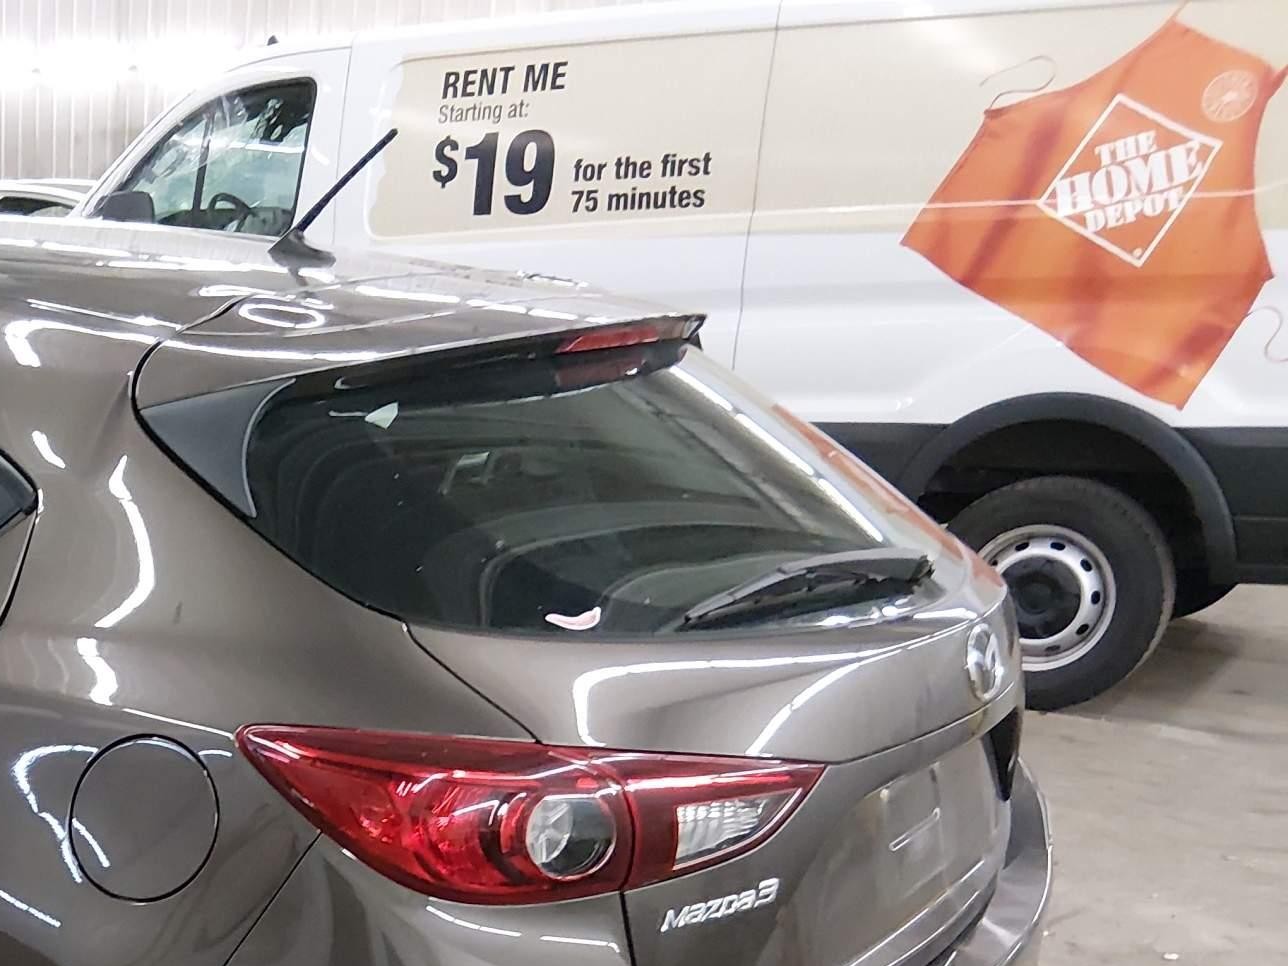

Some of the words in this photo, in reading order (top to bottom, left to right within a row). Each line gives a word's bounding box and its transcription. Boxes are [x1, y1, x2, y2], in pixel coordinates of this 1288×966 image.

[442, 66, 515, 99] RENT
[523, 61, 568, 92] ME
[438, 102, 502, 124] Starting
[507, 100, 530, 119] at:
[573, 159, 607, 182] for
[614, 156, 652, 180] the
[661, 152, 712, 178] first
[1094, 130, 1158, 167] THE
[432, 129, 555, 216] $19
[1052, 141, 1206, 218] HOME
[571, 189, 599, 213] 75
[606, 186, 706, 212] minutes
[1083, 187, 1185, 234] DEPOT
